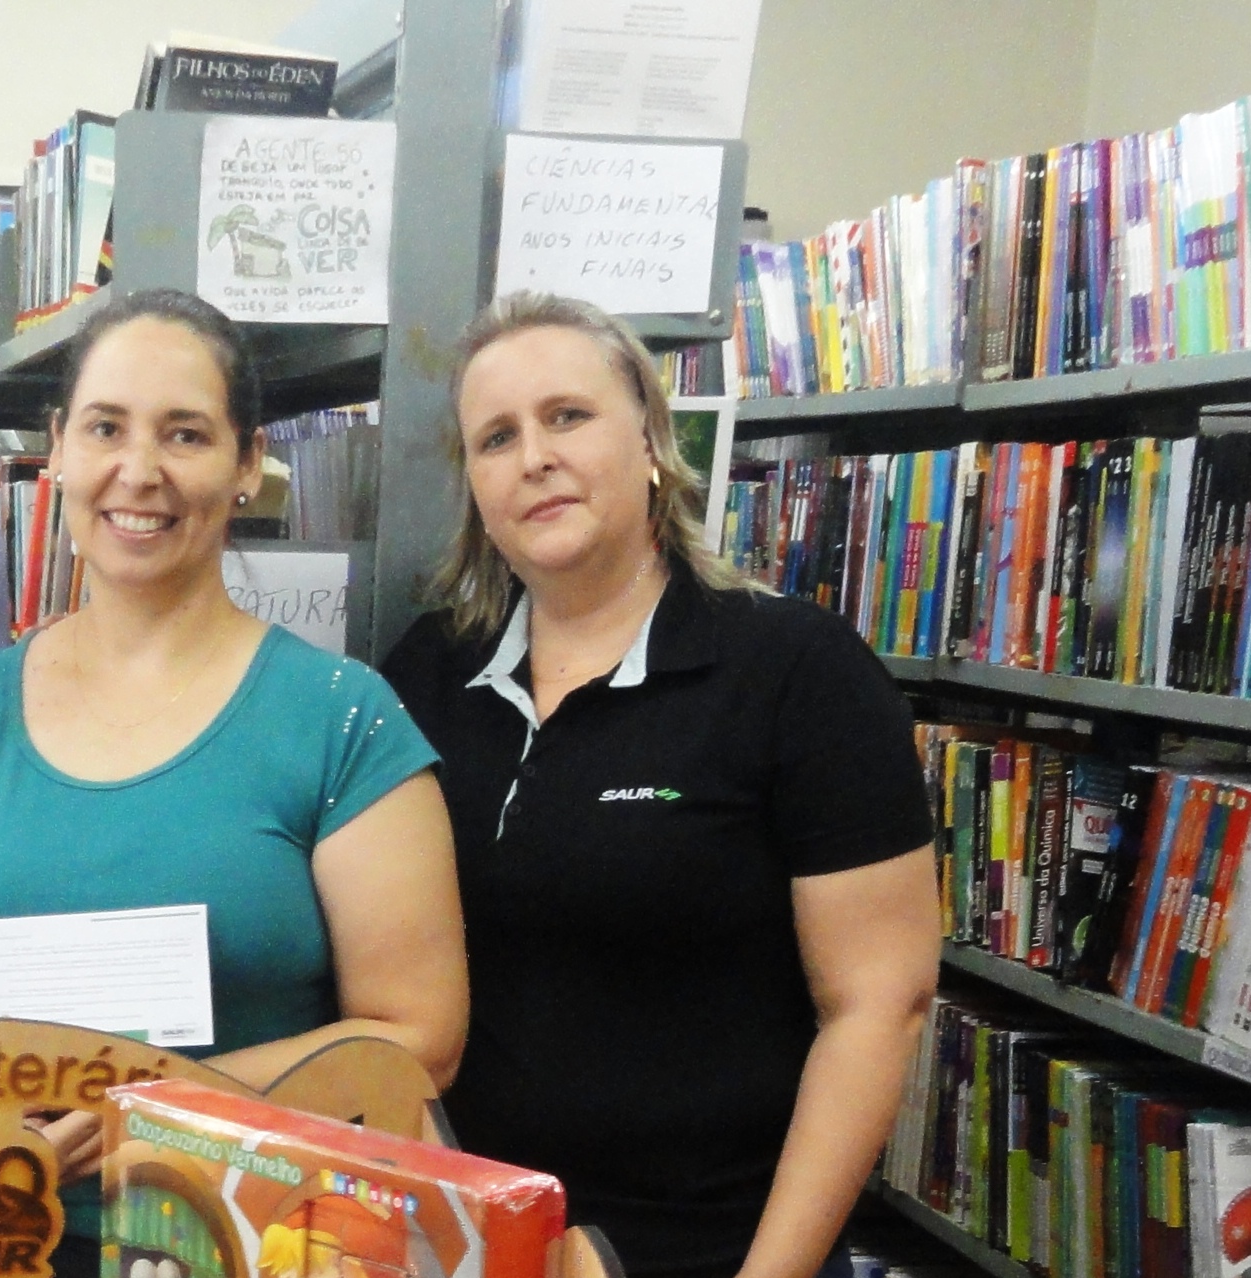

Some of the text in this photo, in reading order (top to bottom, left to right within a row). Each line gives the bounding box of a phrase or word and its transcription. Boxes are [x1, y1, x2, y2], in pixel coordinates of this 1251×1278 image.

[172, 56, 250, 80] FILHOS
[268, 61, 325, 85] ÉDEN
[525, 146, 657, 180] CIÊNCIAS
[298, 203, 372, 239] COISA
[520, 230, 687, 252] ANOS INICIAIS
[298, 247, 359, 275] VER
[581, 257, 674, 284] FINAIS
[227, 585, 348, 626] ATURA
[598, 787, 655, 801] SAUR
[1035, 868, 1050, 887] da
[1031, 889, 1052, 948] Universo
[225, 1142, 304, 1188] Vermelho
